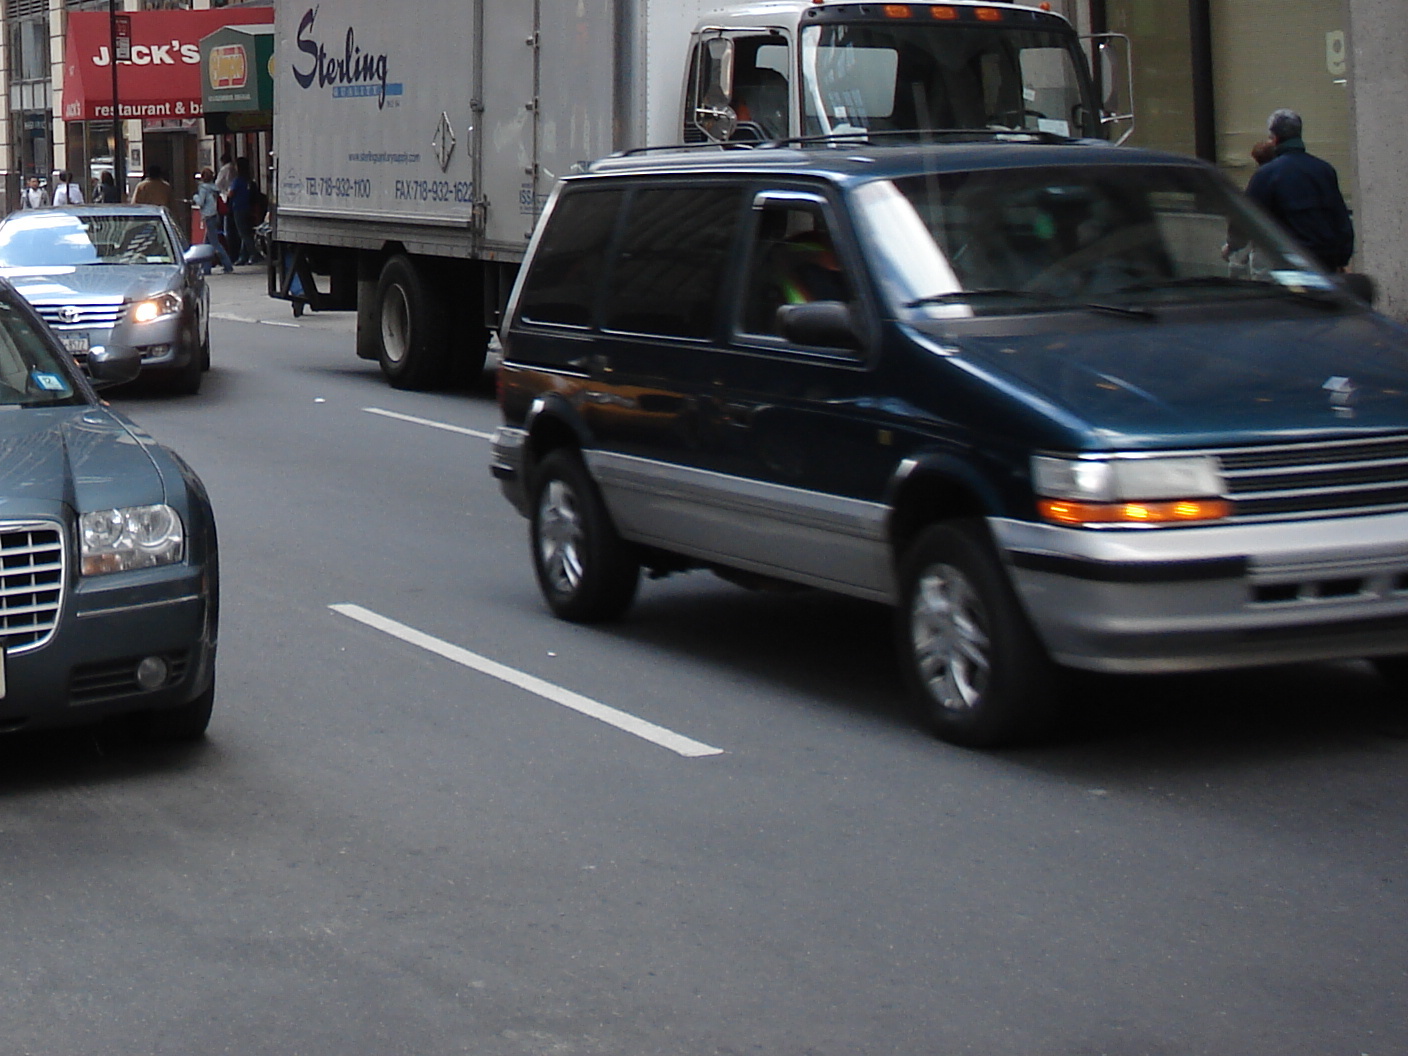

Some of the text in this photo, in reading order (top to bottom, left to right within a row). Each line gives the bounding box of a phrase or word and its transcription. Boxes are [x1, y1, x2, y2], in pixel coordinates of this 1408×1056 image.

[92, 40, 202, 66] JCK'S
[292, 4, 388, 111] Sterling
[175, 102, 186, 115] &
